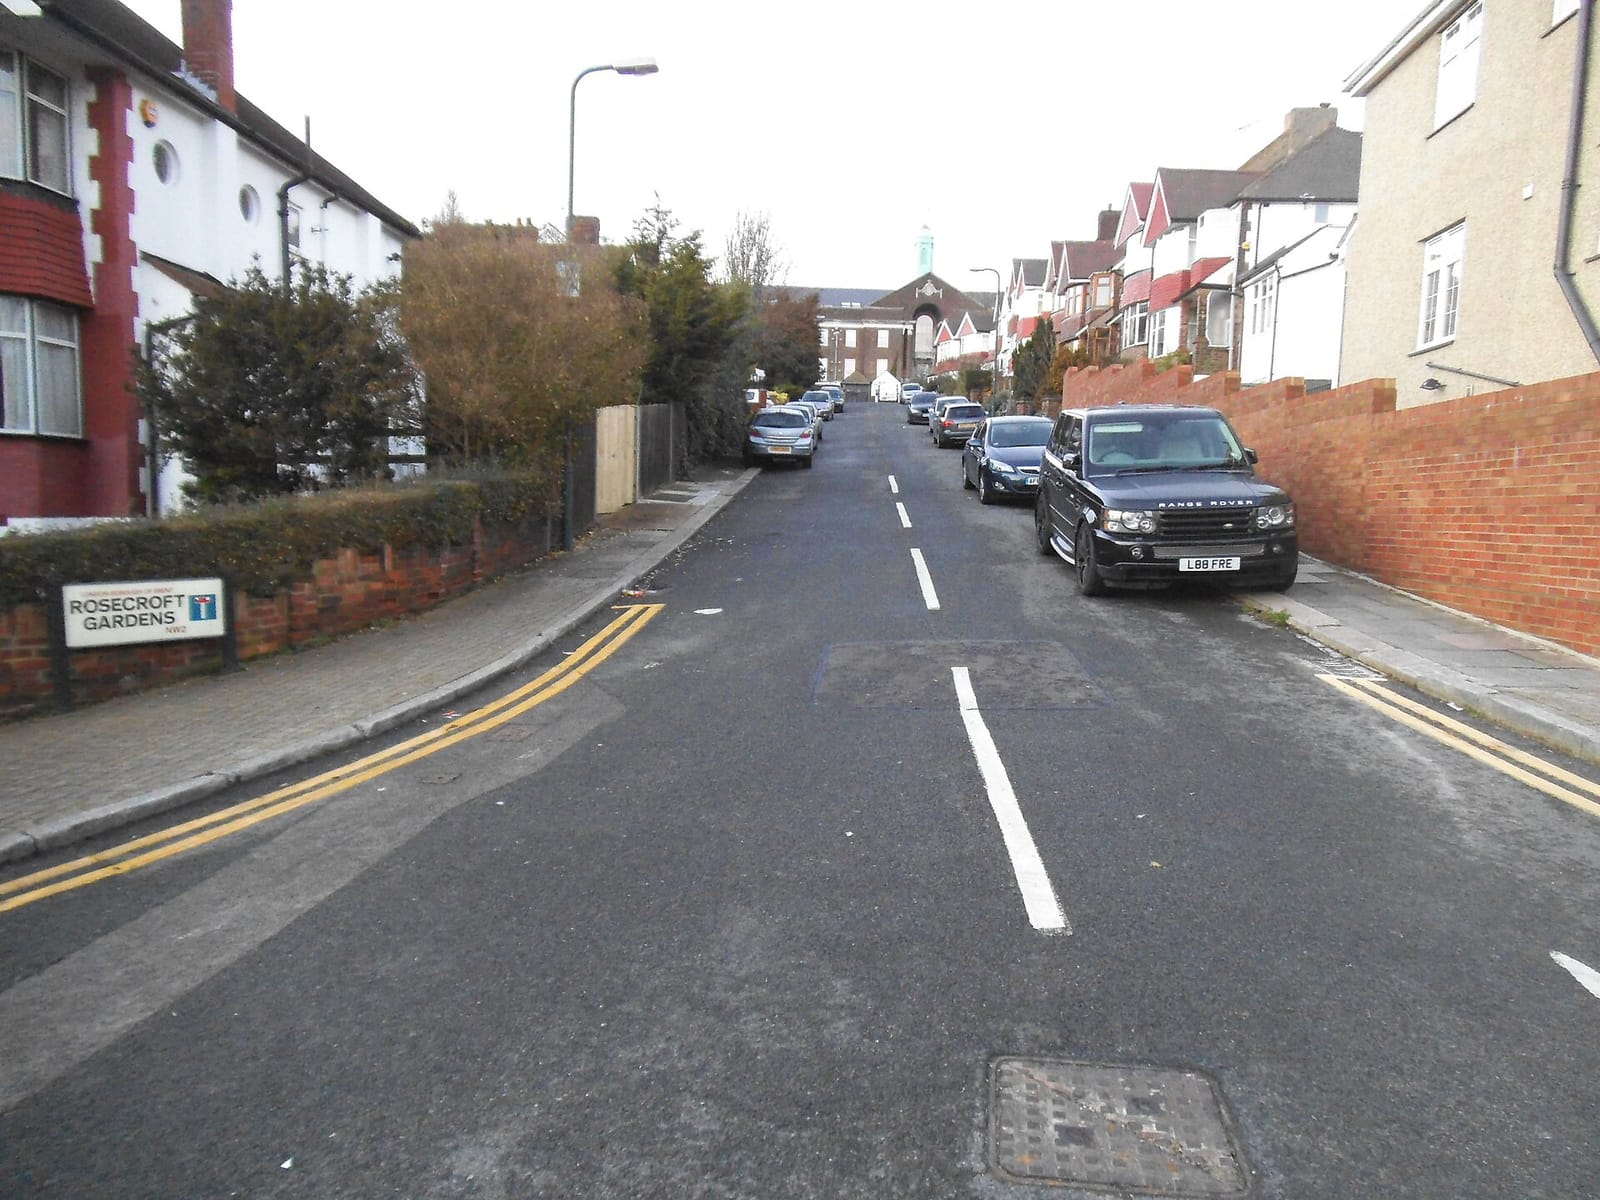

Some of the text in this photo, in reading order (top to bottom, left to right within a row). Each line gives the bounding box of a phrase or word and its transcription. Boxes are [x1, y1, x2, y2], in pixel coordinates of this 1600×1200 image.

[1158, 500, 1203, 508] RANGE
[1211, 558, 1233, 569] FRE
[70, 594, 185, 615] ROSECROFT
[83, 611, 176, 631] GARDENS
[165, 626, 187, 634] NW2
